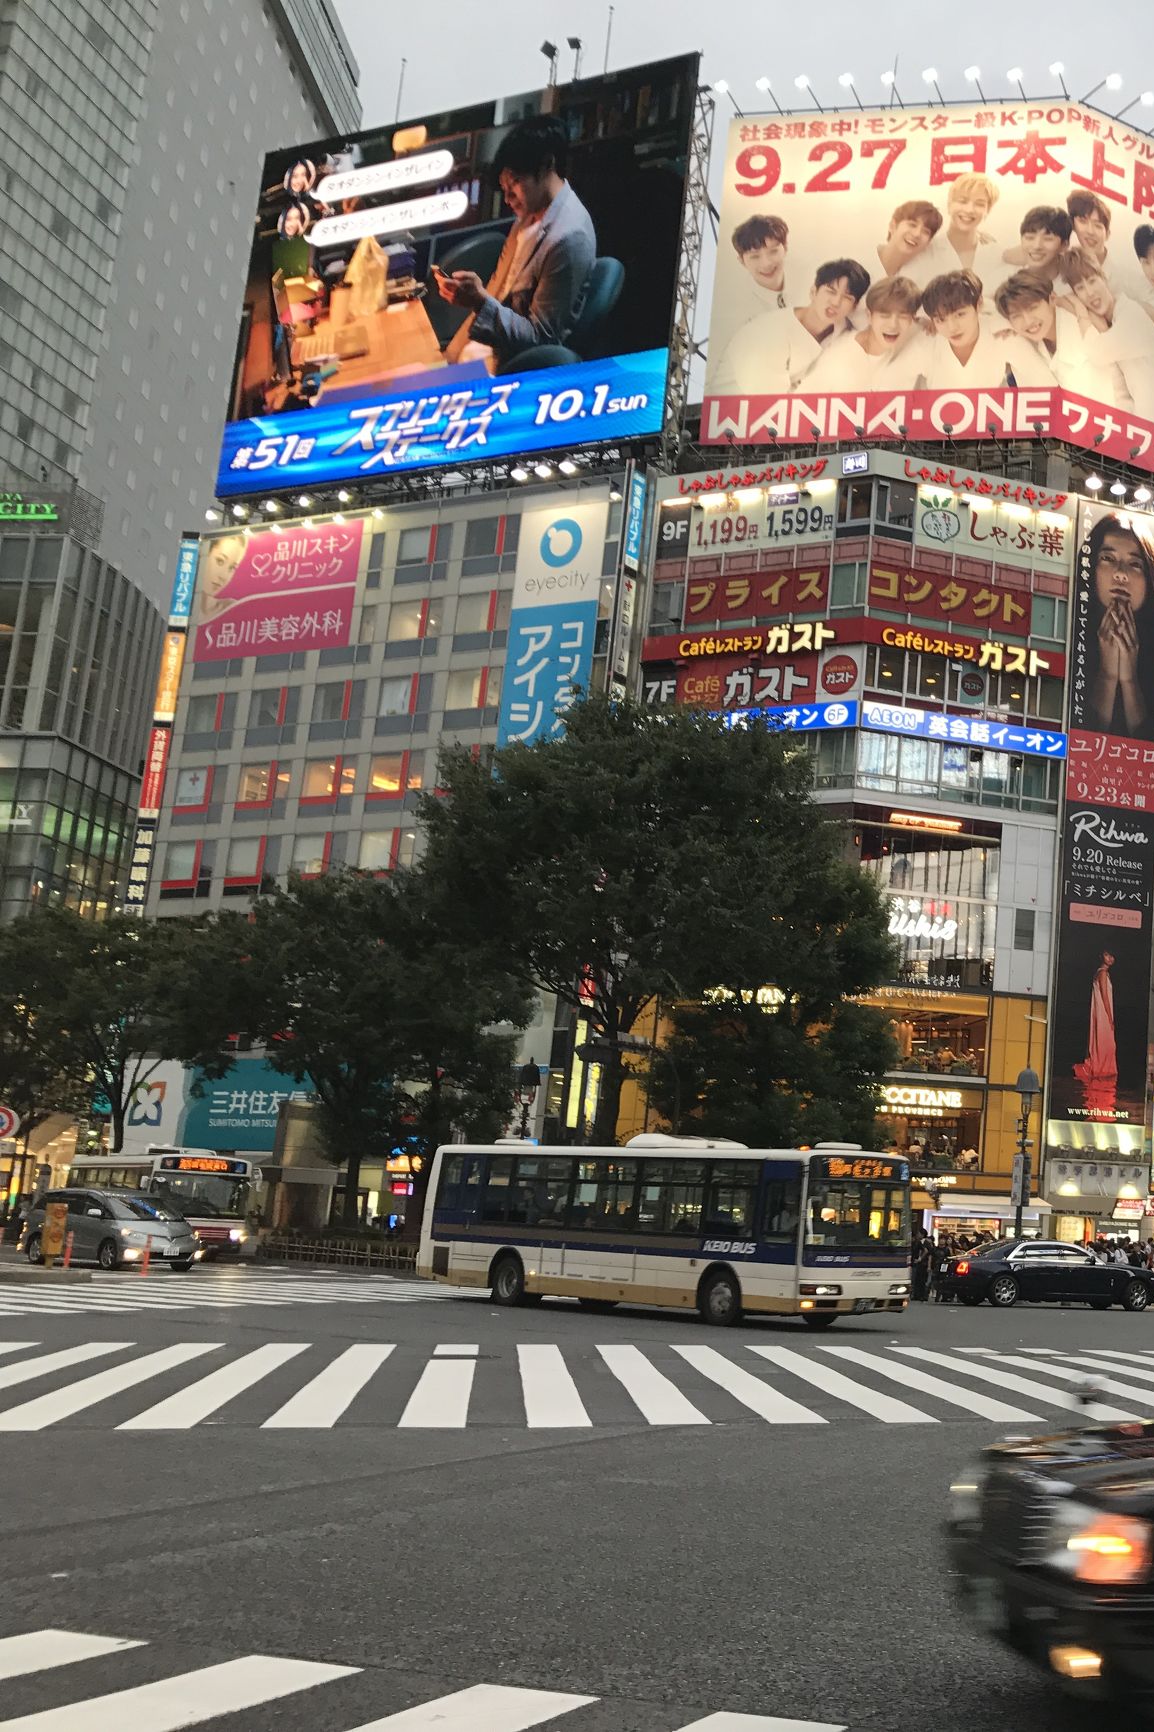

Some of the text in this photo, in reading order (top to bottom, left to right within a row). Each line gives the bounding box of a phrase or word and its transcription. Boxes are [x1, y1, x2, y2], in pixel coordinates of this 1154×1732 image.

[740, 118, 859, 142] 社会現象中!
[733, 139, 907, 196] 9.27
[333, 382, 520, 456] スプリンターズ
[230, 434, 316, 471] 第51回
[678, 458, 829, 494] しゃぶしゃぶバイキング
[904, 458, 1069, 510] しゃぶしゃぶバイキング
[662, 520, 688, 541] 9F
[696, 516, 759, 550] 1,199円
[767, 506, 833, 542] 1,599円
[970, 511, 1065, 557] しゃぶ葉
[273, 534, 355, 561] 品川スキン
[272, 558, 344, 584] クリニック
[524, 570, 590, 596] eyecity
[688, 572, 826, 614] プライス
[870, 569, 1025, 623] コンタクト
[216, 608, 344, 648] 品川美容外科
[766, 621, 835, 655] ガスト
[978, 642, 1050, 677] ガスト
[645, 680, 676, 703] 7F
[684, 675, 720, 694] Café
[723, 666, 809, 707] ガスト
[826, 673, 853, 684] ガスト
[828, 707, 845, 721] 6F
[869, 707, 1063, 753] AEON 英会話イーオン
[1069, 810, 1149, 848] Rihwa
[1072, 846, 1143, 870] 9.20 Release
[1065, 880, 1149, 907] 「ミチシルベ」
[209, 1119, 249, 1128] SUMITOMO
[1067, 1107, 1129, 1119] www.rihwa.net
[703, 1240, 757, 1254] KEIO BUS
